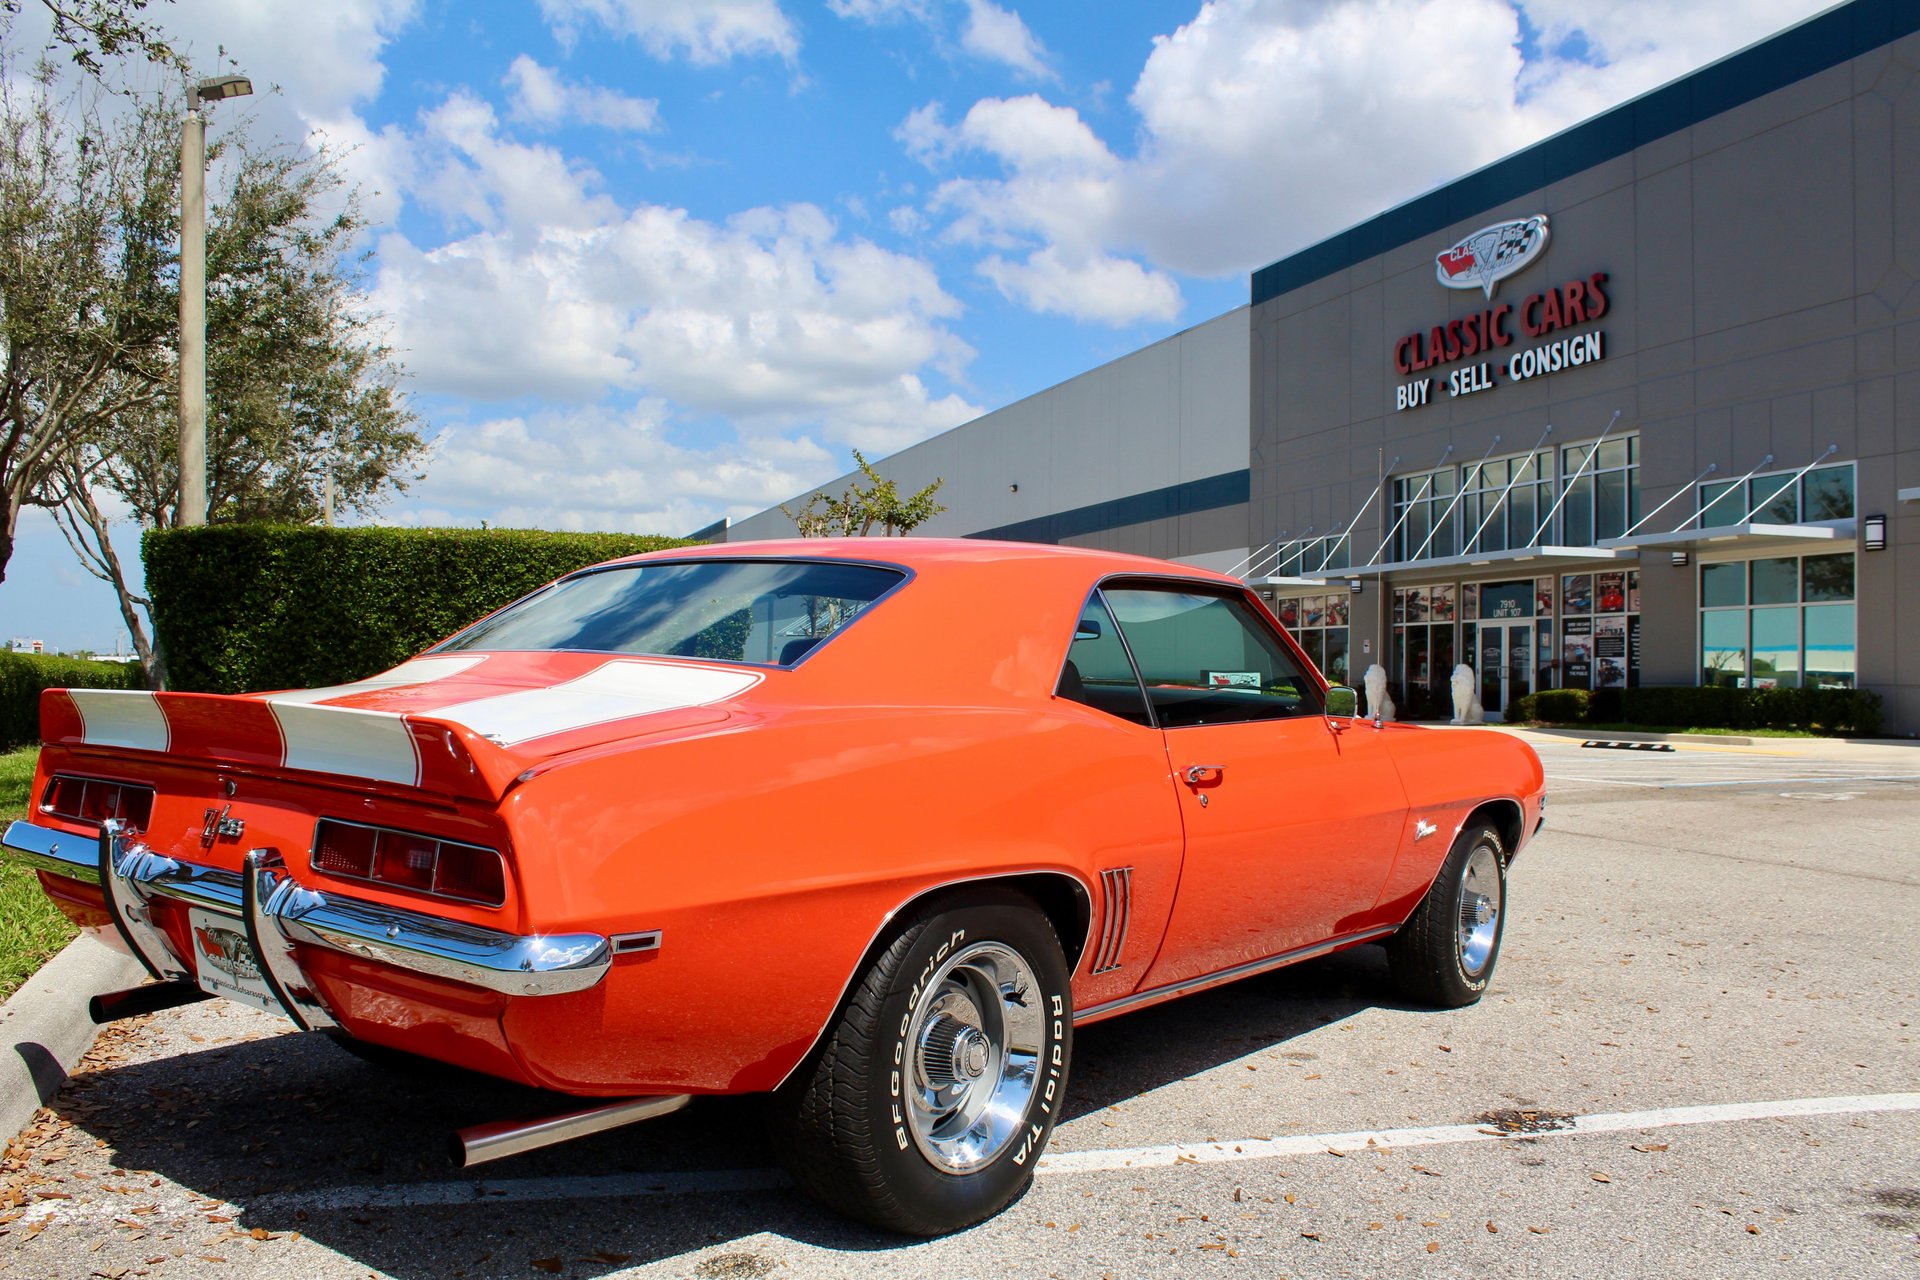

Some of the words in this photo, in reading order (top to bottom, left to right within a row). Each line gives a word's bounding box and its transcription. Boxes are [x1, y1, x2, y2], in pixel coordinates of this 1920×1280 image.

[1450, 239, 1493, 261] CLASSIC
[1394, 304, 1511, 375] CLASSIC
[1520, 273, 1608, 338] CARS
[1397, 378, 1430, 411] BUY
[1450, 363, 1493, 397] SELL
[1509, 331, 1601, 381] CONSIGN
[1493, 609, 1508, 618] UNIT
[1510, 608, 1522, 617] 107
[1500, 599, 1516, 608] 7910
[891, 928, 966, 1151] BFGoodrich
[1041, 995, 1064, 1114] Radial
[1012, 1124, 1044, 1167] T/A
